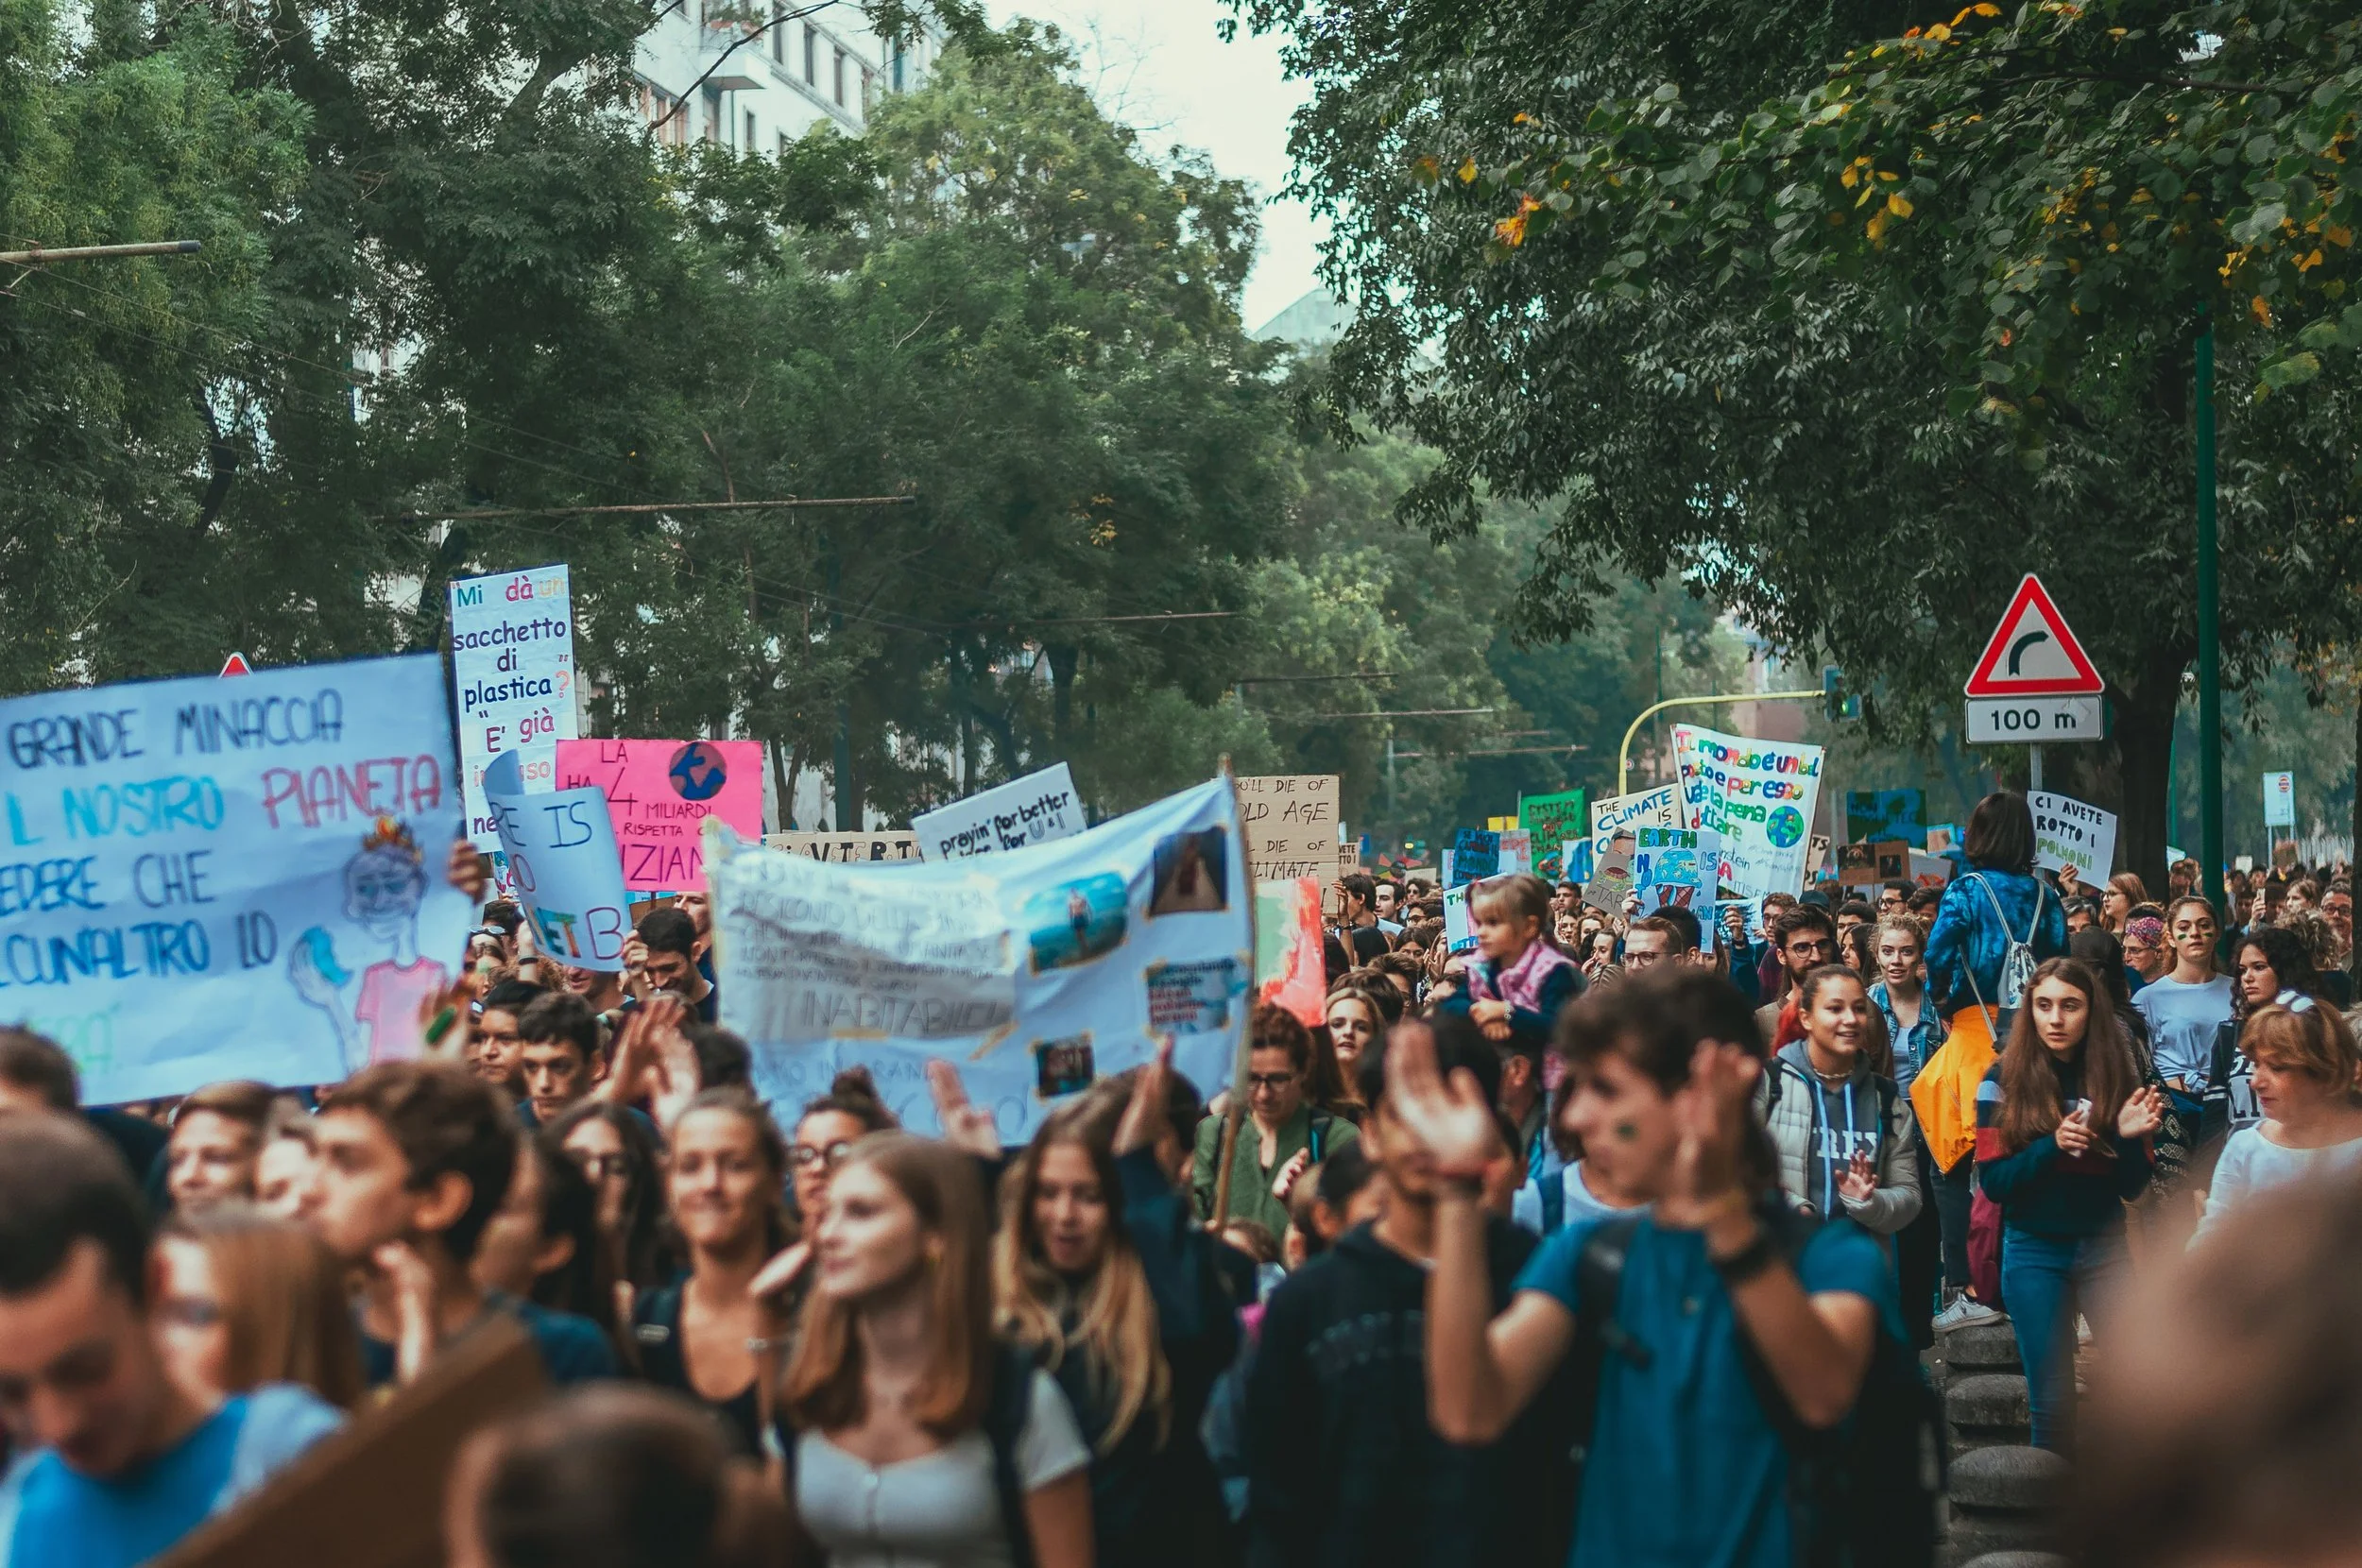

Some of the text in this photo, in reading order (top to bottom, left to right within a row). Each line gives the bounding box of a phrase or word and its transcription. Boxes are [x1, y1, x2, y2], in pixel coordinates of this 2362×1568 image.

[505, 574, 534, 602] dà
[539, 576, 565, 597] un
[454, 617, 567, 652] sacchetto
[497, 647, 518, 672] di
[7, 688, 343, 770] GRANDE MINACCIA
[520, 707, 556, 743] già
[1991, 709, 2077, 731] 100 m
[601, 741, 628, 763] LA
[1698, 739, 1761, 770] mondo
[1776, 756, 1799, 775] un
[607, 766, 639, 817] 4
[1274, 779, 1296, 793] DIE
[1308, 778, 1328, 792] OF
[1715, 771, 1726, 787] e
[1727, 776, 1762, 797] per
[4, 754, 440, 846] L NOSTRO PIANETA
[646, 803, 711, 820] MILIARDI
[1282, 800, 1329, 825] AGE
[1597, 801, 1619, 814] THE
[1597, 788, 1672, 831] CLIMATE
[1710, 785, 1724, 810] la
[1724, 801, 1767, 824] pena
[2035, 796, 2102, 826] CI AVETE
[543, 800, 592, 849] IS
[624, 822, 683, 837] RISPETTA
[993, 810, 1018, 844] for
[1018, 791, 1070, 824] better
[1657, 809, 1671, 822] IS
[1638, 827, 1697, 848] EARTH
[2036, 815, 2096, 848] ROTTO I
[1264, 839, 1289, 854] DIE
[1307, 840, 1327, 851] OF
[1700, 851, 1718, 871] IS
[2036, 837, 2093, 871] POLMONI
[0, 848, 219, 917] EDERE CHE
[1249, 861, 1320, 880] LIMATE
[233, 909, 278, 969] LO
